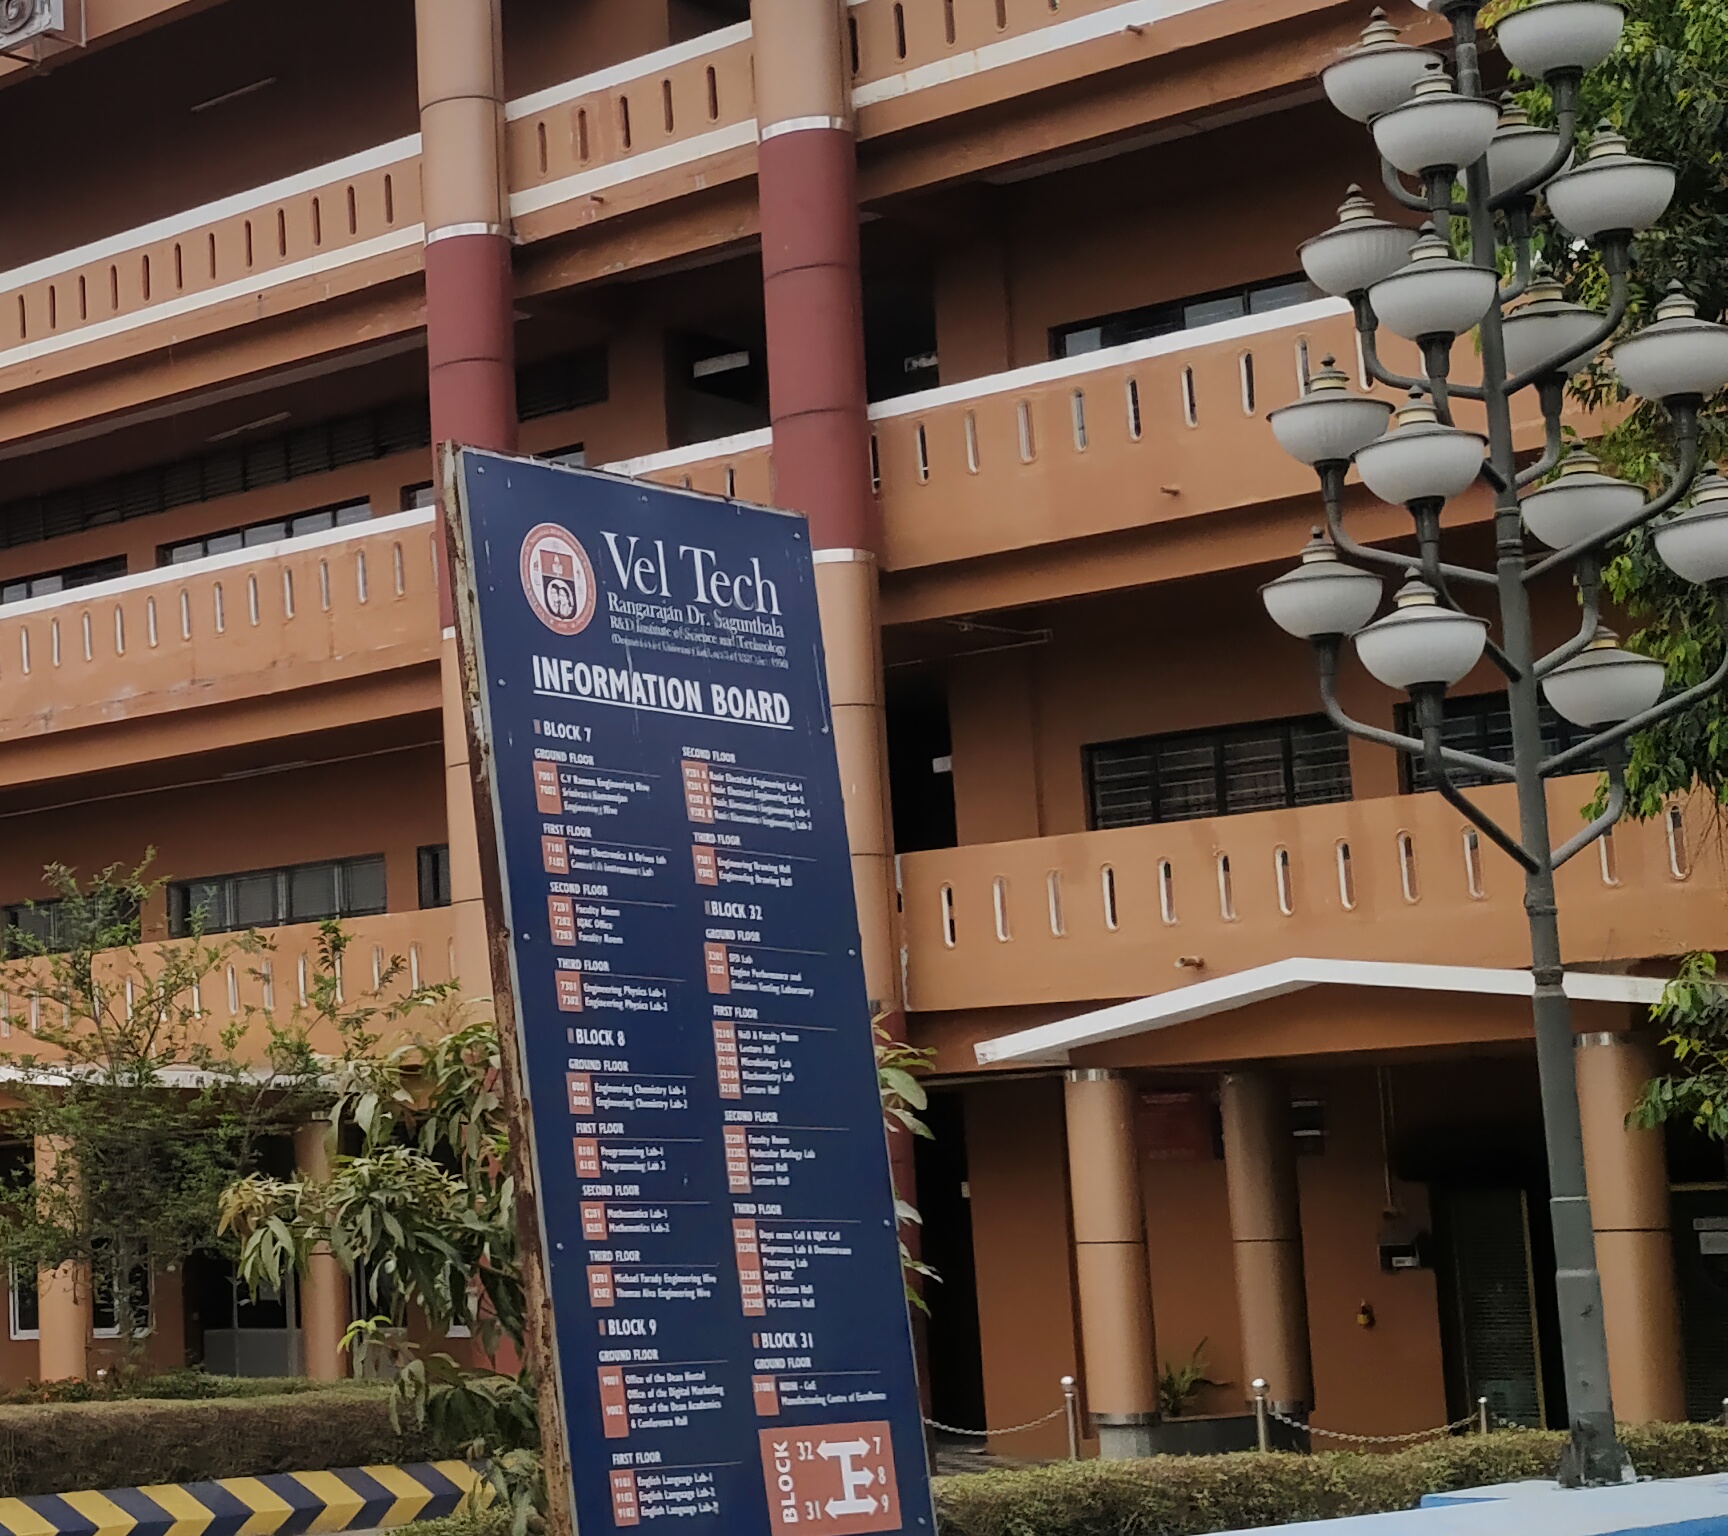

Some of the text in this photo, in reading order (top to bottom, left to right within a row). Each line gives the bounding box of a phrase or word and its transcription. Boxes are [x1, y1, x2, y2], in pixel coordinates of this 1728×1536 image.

[599, 530, 671, 597] Vel
[678, 544, 782, 615] Tech
[606, 591, 784, 638] Rangarajan Dr. Sagunthala
[532, 654, 790, 723] INFORMATION BOARD
[543, 720, 591, 742] BLOCK 7
[568, 752, 594, 765] FLOOR
[681, 745, 736, 763] SECOND FLOOR
[542, 822, 592, 837] FIRST FLOOR
[549, 881, 608, 896] SECOND FLOOR
[710, 900, 763, 920] BLOCK 32
[556, 957, 610, 971] THIRD FLOOR
[712, 1004, 758, 1019] FIRST FLOOR
[575, 1028, 625, 1046] BLOCK 8
[568, 1058, 629, 1072] GROUND FLOOR
[575, 1122, 624, 1134] FIRST FLOOR
[581, 1184, 639, 1196] SECOND FLOOR
[732, 1202, 782, 1215] THIRD FLOOR
[588, 1249, 640, 1261] THIRD FLOOR
[607, 1318, 656, 1335] BLOCK 9
[760, 1332, 813, 1348] BLOCK 31
[598, 1348, 659, 1362] GROUND FLOOR
[753, 1356, 811, 1369] GROUND FLOOR
[795, 1436, 881, 1460] 32 7
[611, 1450, 661, 1465] FIRST FLOOR
[772, 1440, 798, 1523] BLOCK
[877, 1465, 886, 1484] 8
[804, 1493, 889, 1520] 31 9
